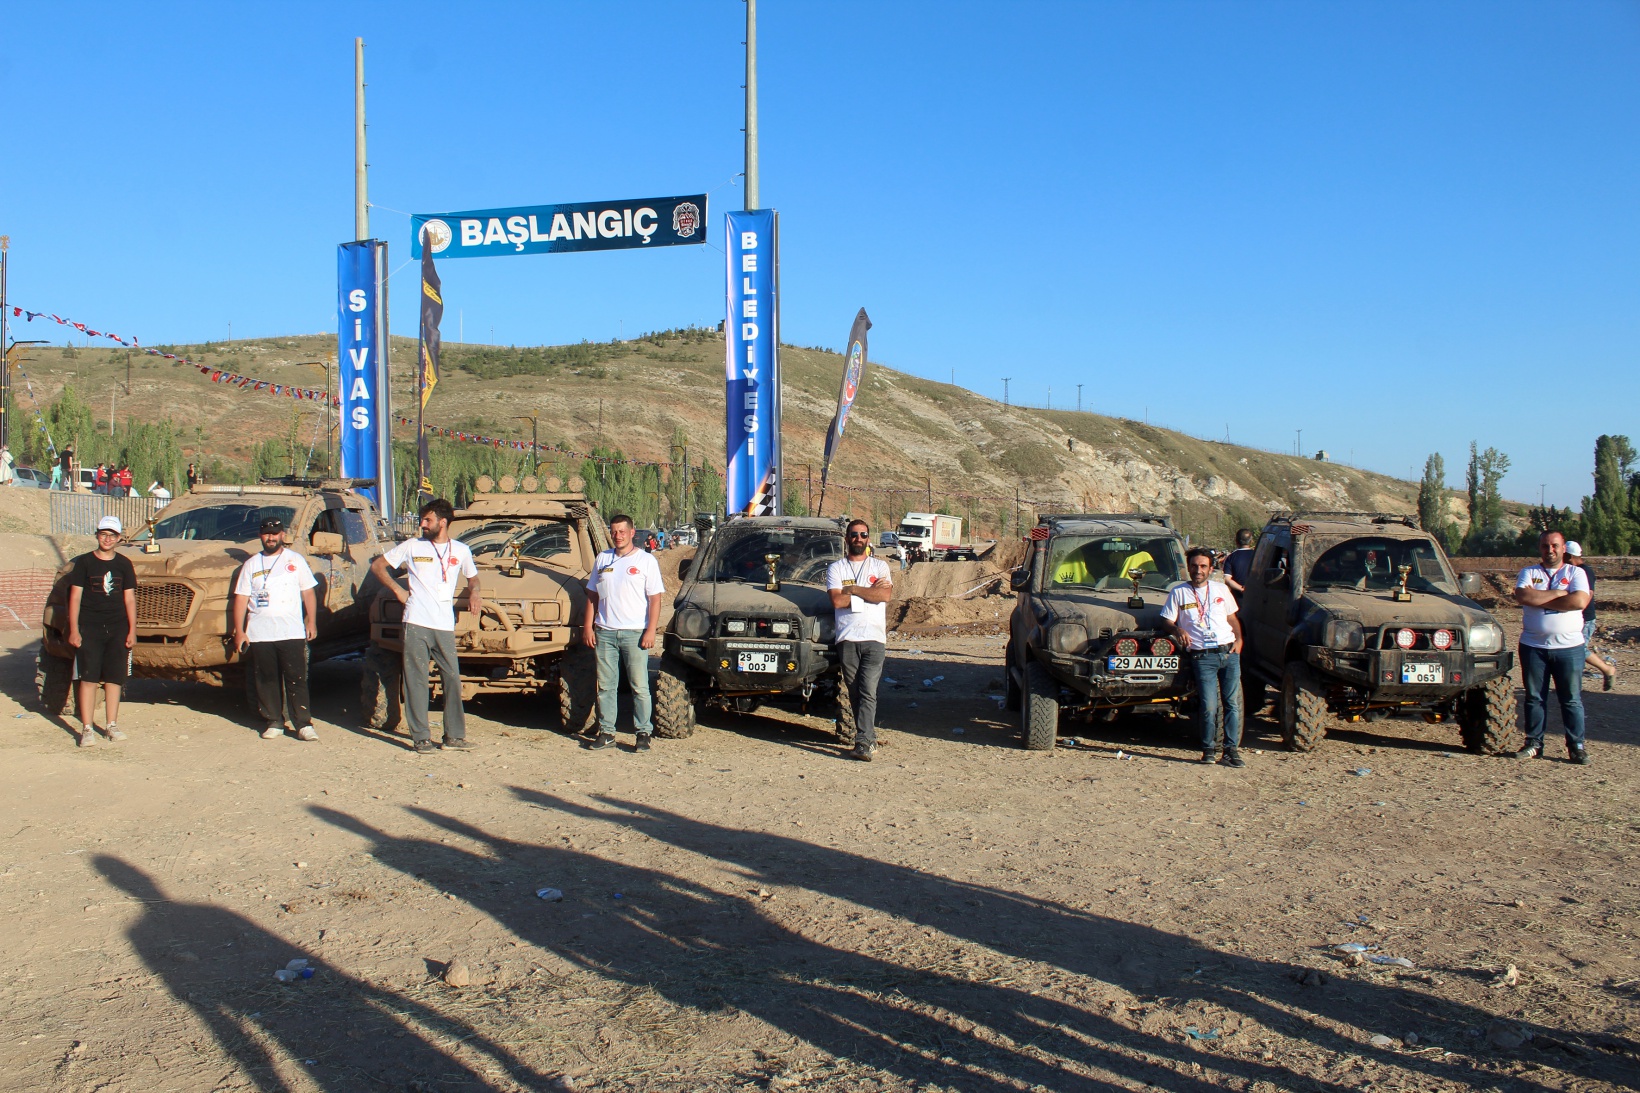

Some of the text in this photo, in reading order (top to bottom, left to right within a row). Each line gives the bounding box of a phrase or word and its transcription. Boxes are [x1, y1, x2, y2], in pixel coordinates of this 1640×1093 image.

[460, 207, 658, 251] BAŞLANGIÇ
[741, 232, 759, 456] BELEDİYESİ
[349, 289, 369, 430] SİVAS
[740, 653, 776, 662] 29 DB
[748, 663, 766, 671] 003
[1115, 658, 1130, 669] 29
[1134, 658, 1153, 669] AN
[1156, 658, 1178, 669] 456
[1404, 665, 1441, 673] 29 DR
[1417, 674, 1435, 682] 063
